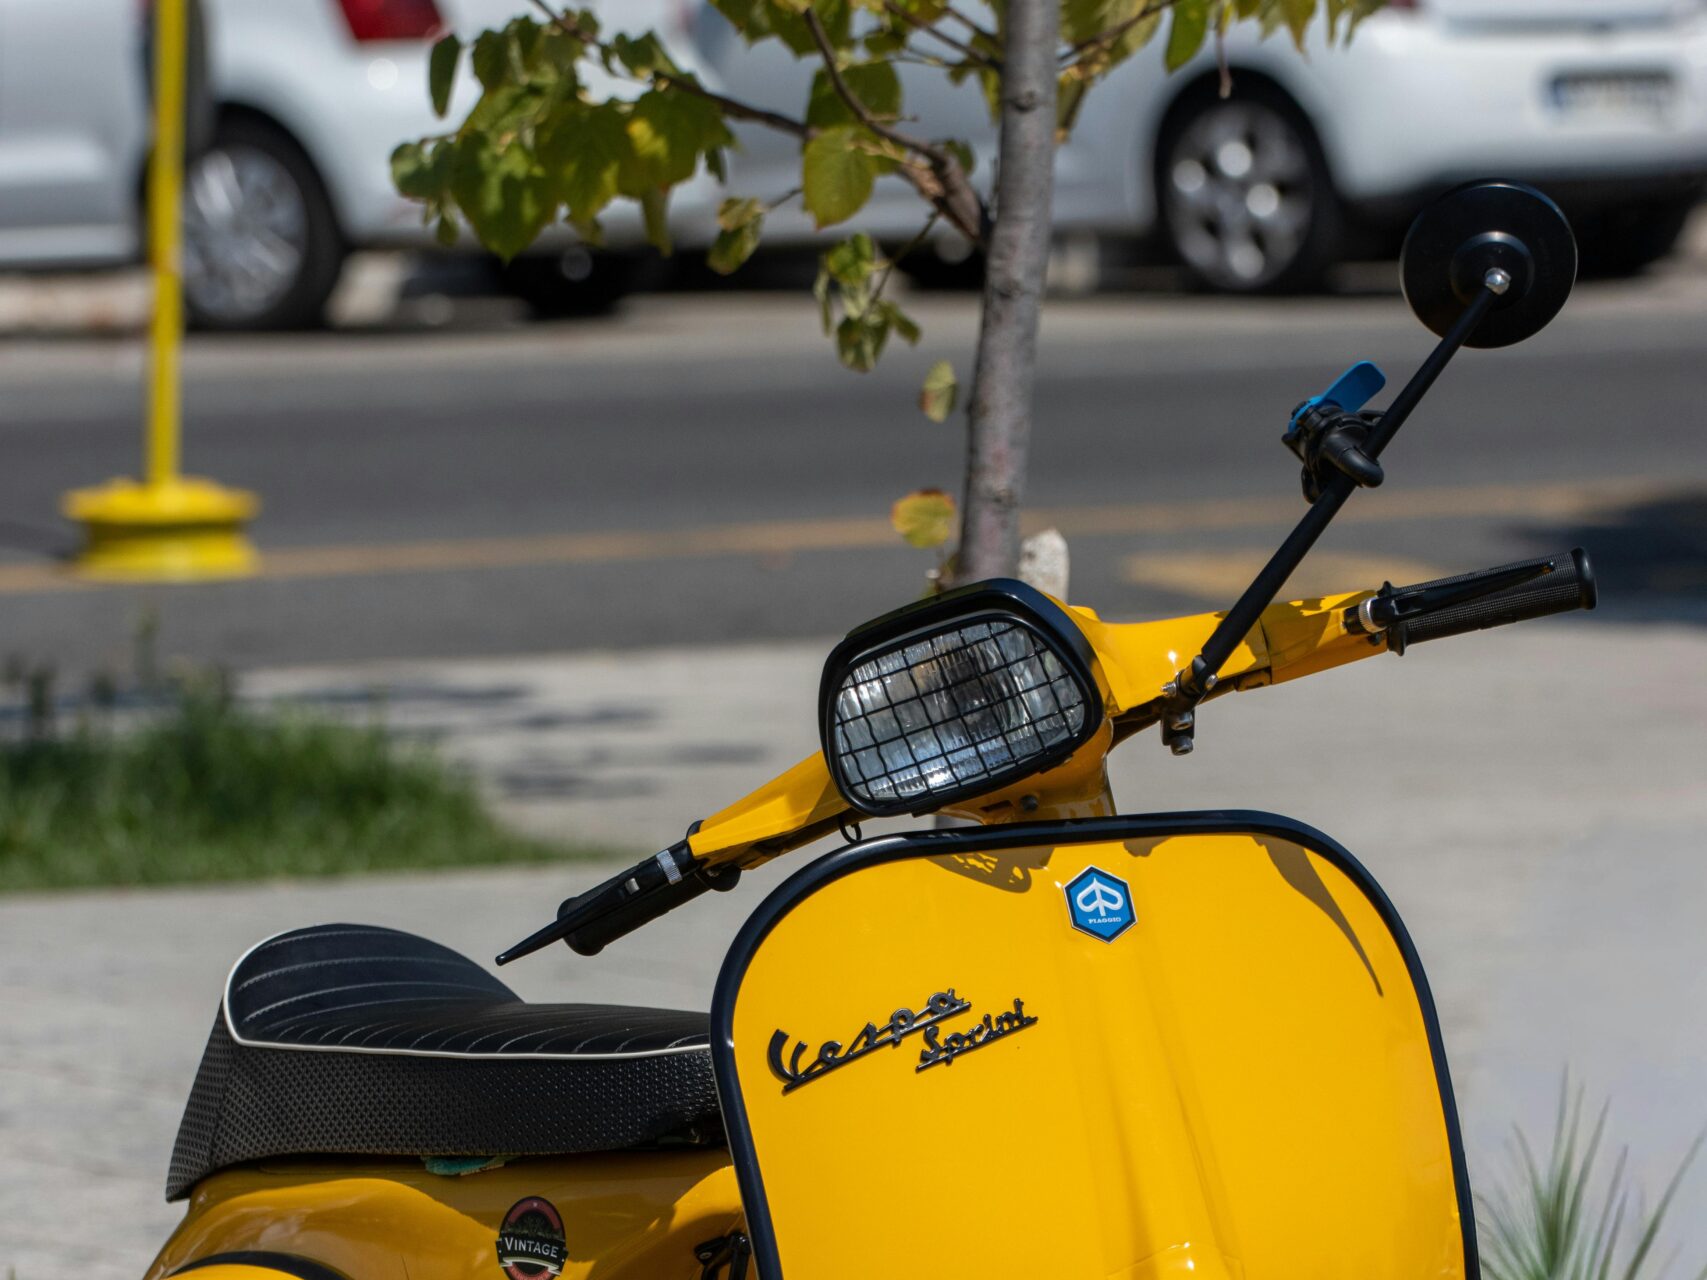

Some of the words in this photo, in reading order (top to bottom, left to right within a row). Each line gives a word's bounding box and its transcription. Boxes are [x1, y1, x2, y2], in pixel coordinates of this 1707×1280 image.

[767, 988, 972, 1093] Vespa
[915, 998, 1038, 1073] Sprint
[504, 1236, 558, 1258] VINTAGE
